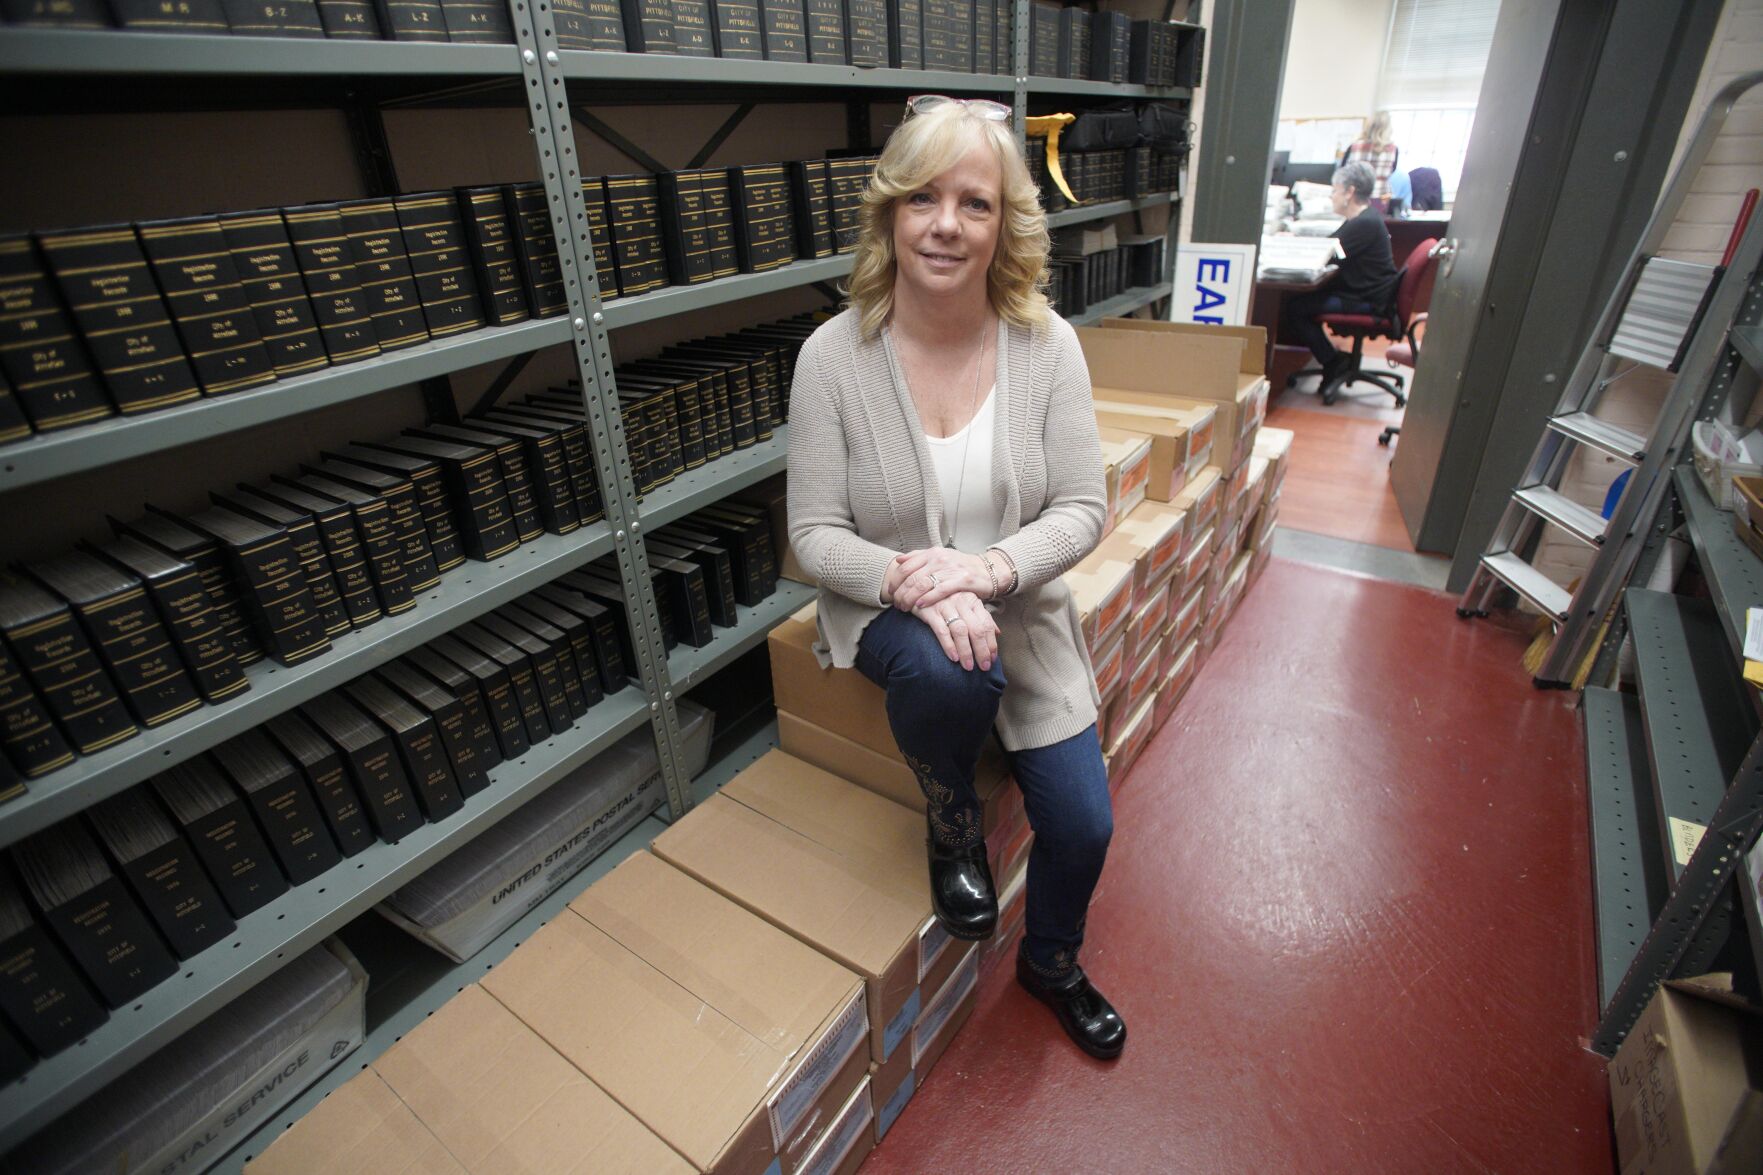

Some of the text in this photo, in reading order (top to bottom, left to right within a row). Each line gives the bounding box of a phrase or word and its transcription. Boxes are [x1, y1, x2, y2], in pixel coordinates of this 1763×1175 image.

[492, 864, 542, 905] UNITED
[544, 826, 590, 868] STATES
[593, 793, 635, 832] POSTAL
[222, 1049, 310, 1129] SERVICE
